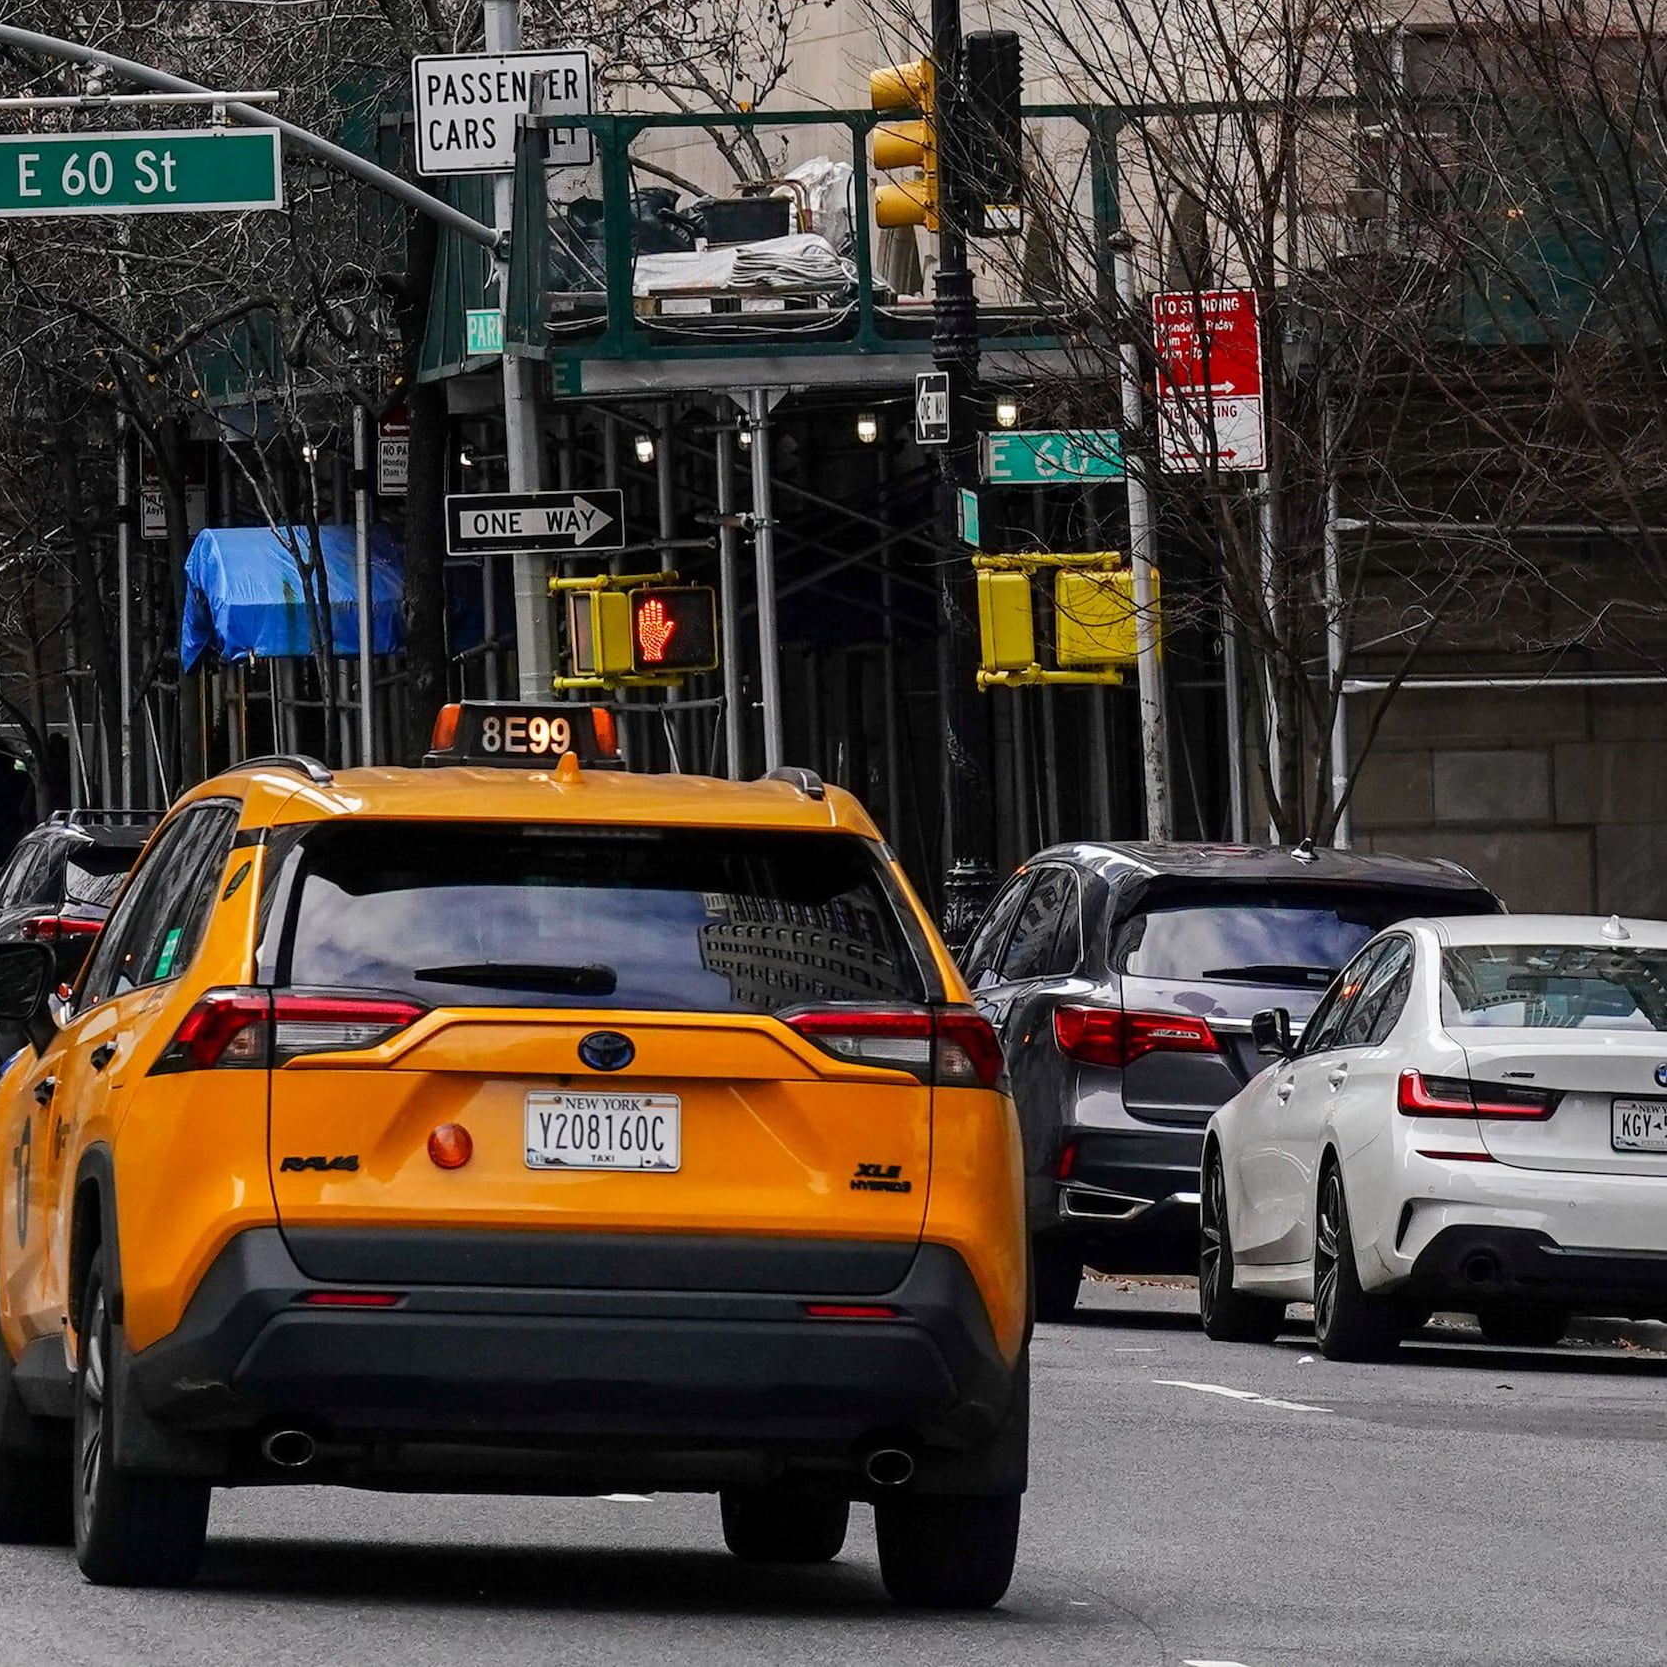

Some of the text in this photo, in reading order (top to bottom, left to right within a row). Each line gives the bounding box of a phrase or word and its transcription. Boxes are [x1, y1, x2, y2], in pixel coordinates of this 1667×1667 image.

[427, 68, 578, 106] PASSENER
[429, 117, 496, 152] CARS
[19, 149, 177, 197] E 60 St
[1180, 297, 1240, 315] STNDING
[382, 445, 395, 455] NO
[990, 438, 1088, 477] E 60
[473, 510, 596, 535] ONE WAY
[481, 716, 572, 755] 8E99
[566, 1097, 641, 1111] NEW YORK
[1639, 1105, 1660, 1113] NEW
[539, 1113, 665, 1152] Y208160C
[1622, 1114, 1651, 1137] KGY
[280, 1154, 360, 1173] RAV4
[591, 1155, 615, 1164] TAXI
